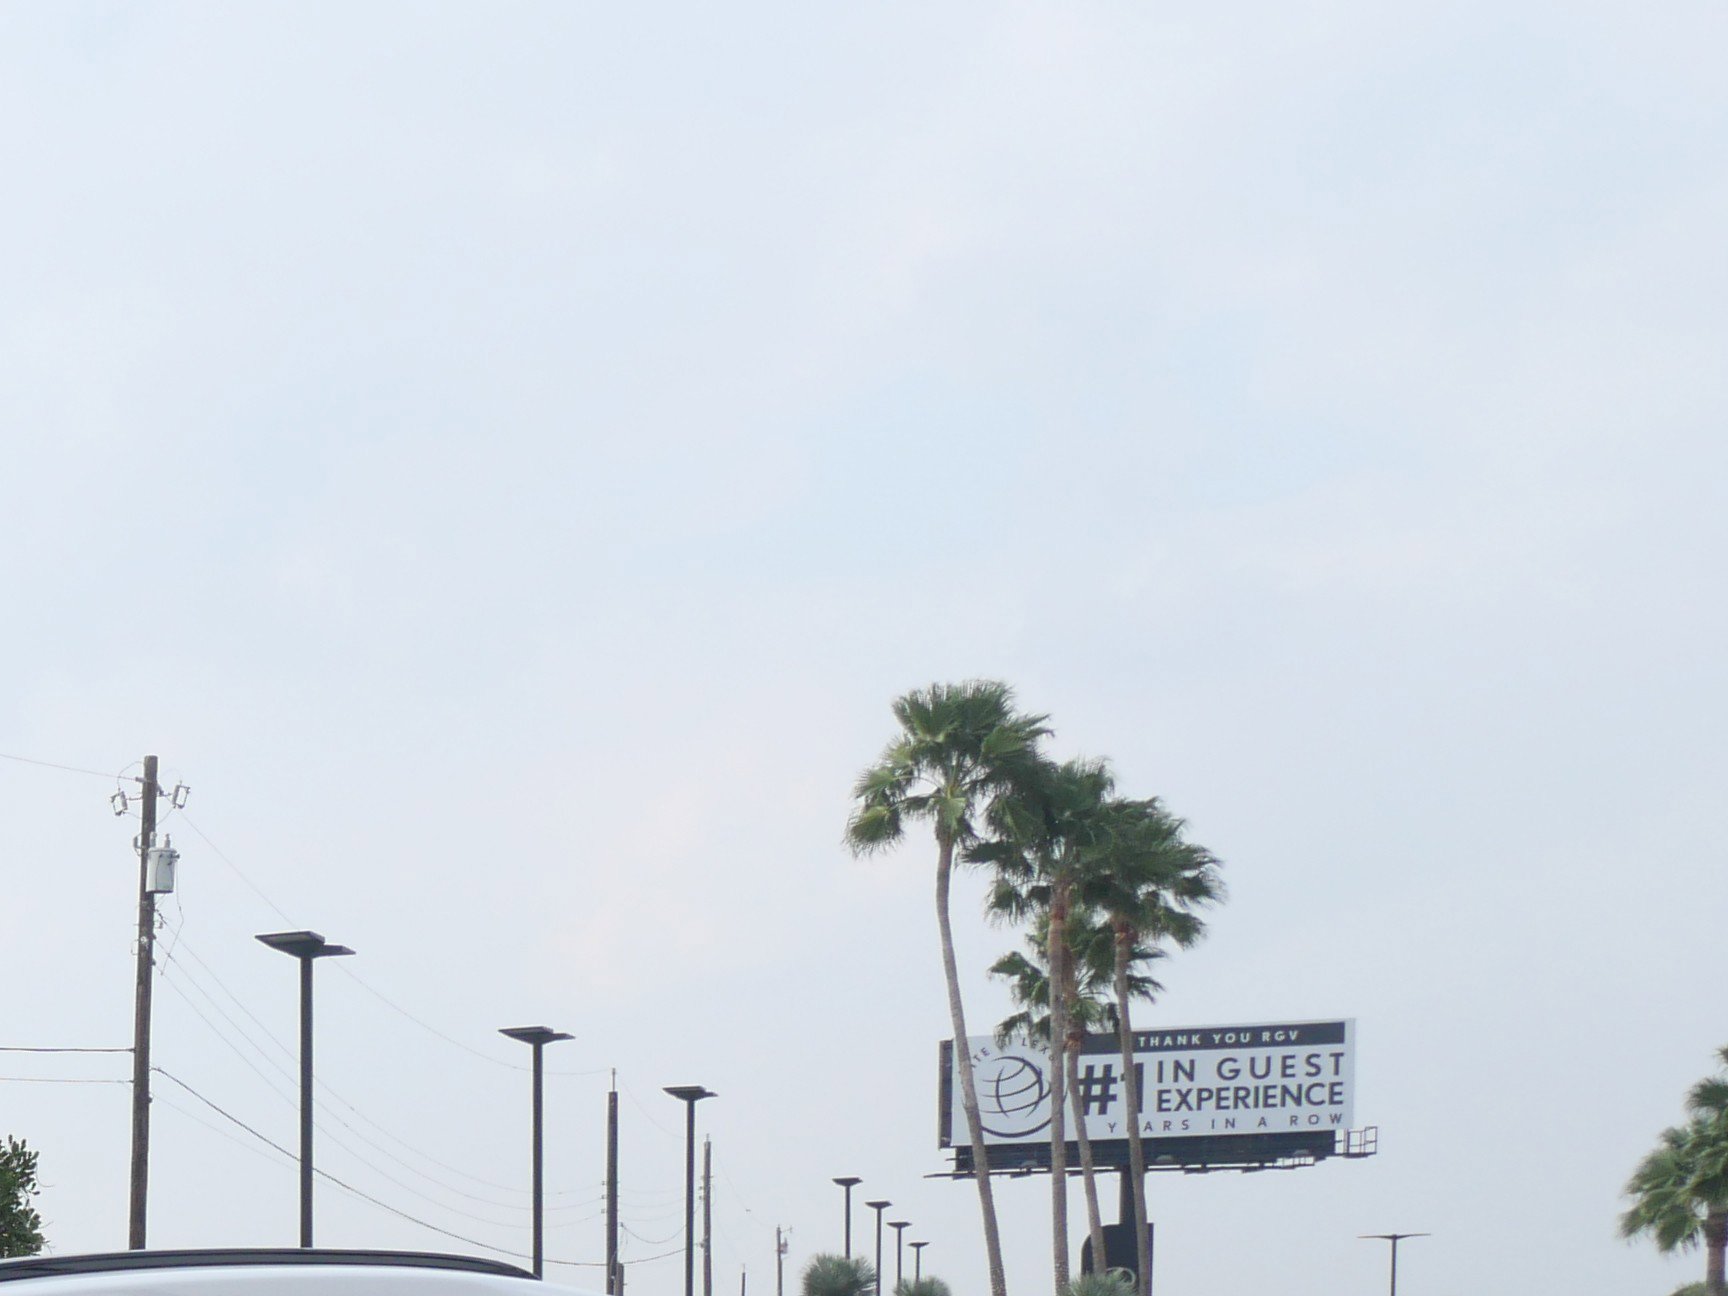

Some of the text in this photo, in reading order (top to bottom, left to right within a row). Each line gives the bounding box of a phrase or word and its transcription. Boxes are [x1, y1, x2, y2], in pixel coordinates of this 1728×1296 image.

[1137, 1030, 1300, 1048] THANK YOU RGV
[1157, 1052, 1345, 1083] IN GUEST
[1156, 1081, 1344, 1112] EXPERIENCE
[1107, 1113, 1343, 1133] YARS IN A ROW
